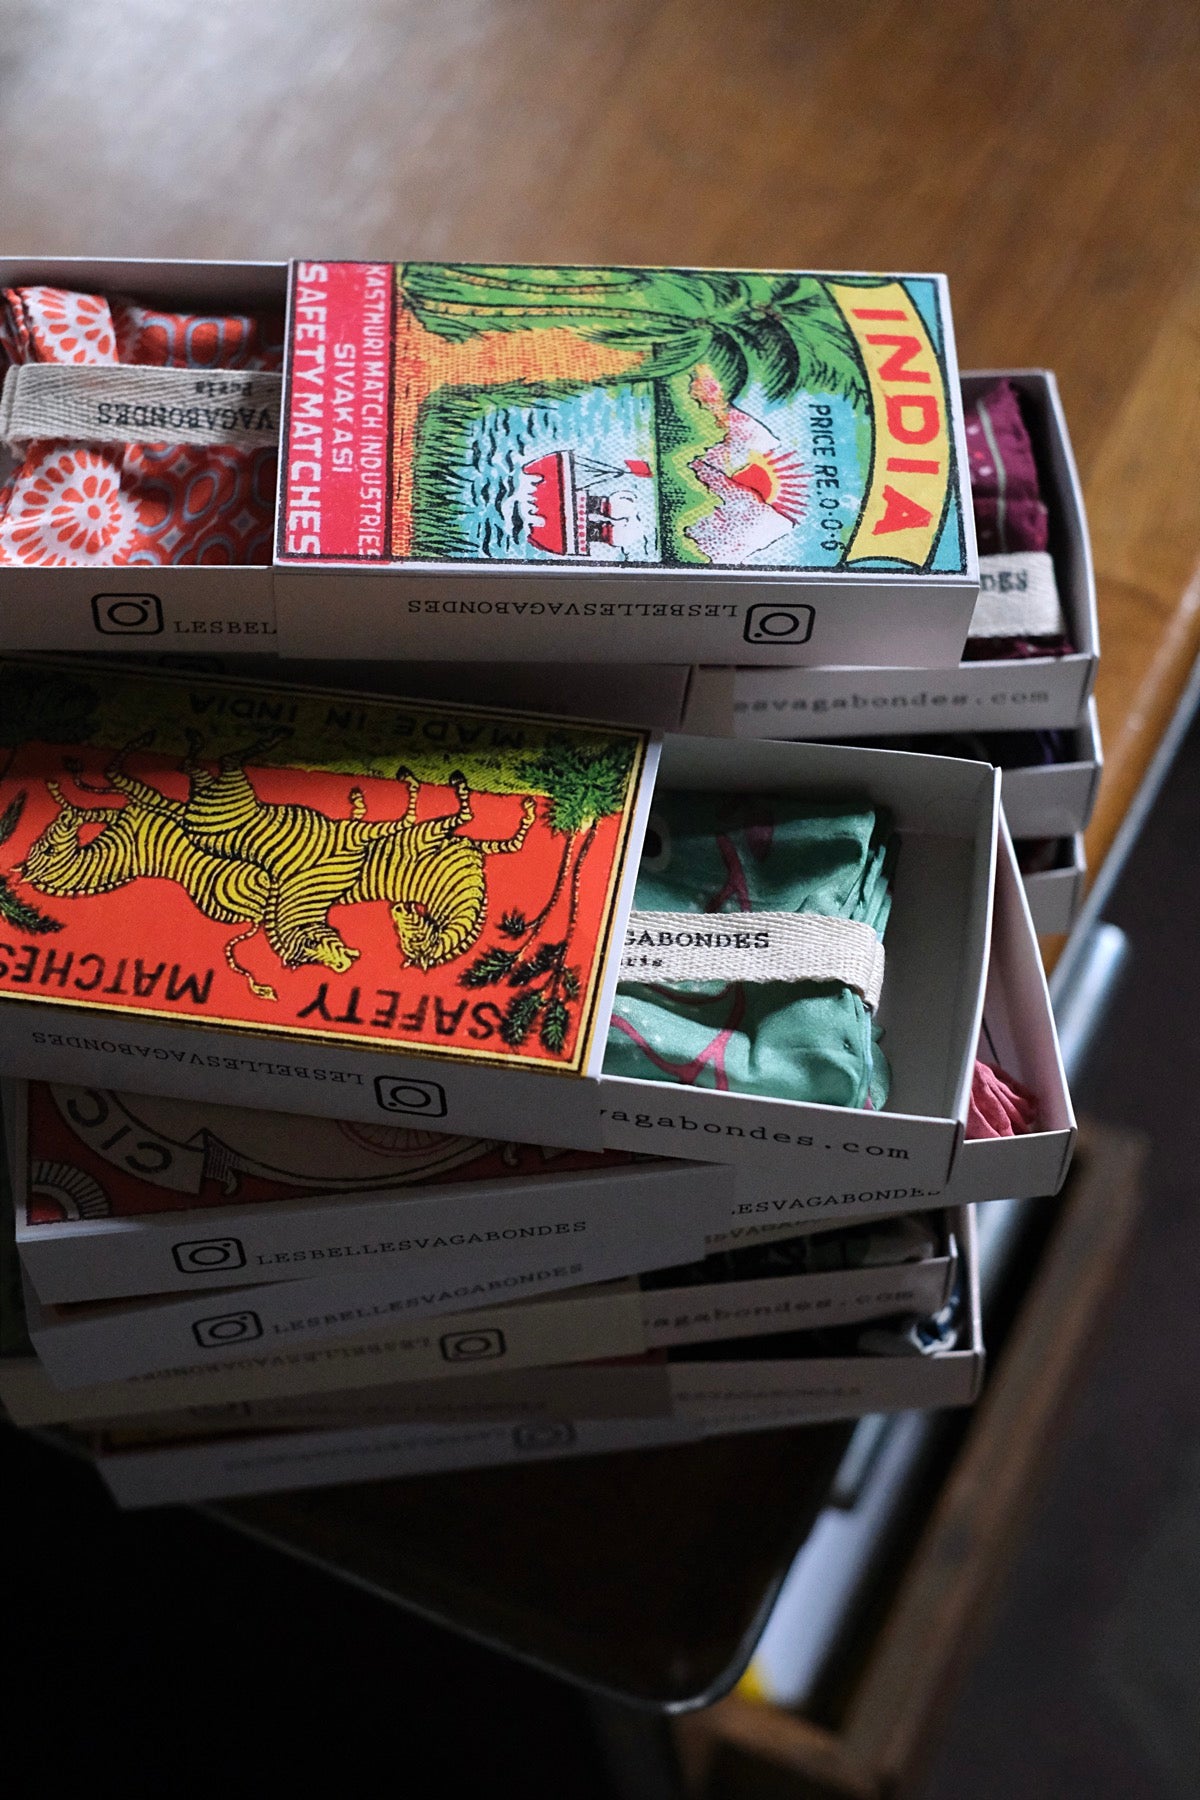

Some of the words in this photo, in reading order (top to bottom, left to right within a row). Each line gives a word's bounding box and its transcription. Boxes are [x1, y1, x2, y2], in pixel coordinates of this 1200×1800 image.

[296, 262, 328, 387] SAFETY
[363, 264, 387, 356] KASTHURI
[97, 402, 277, 430] VAGABONDES
[331, 343, 357, 472] SIVAKASI
[360, 361, 385, 428] MATCH
[809, 404, 836, 457] PRICE
[850, 308, 941, 536] INDIA
[288, 393, 324, 554] MATCHES
[173, 620, 277, 635] LESBEL
[408, 600, 738, 618] LESBELLESVAGABONDES
[187, 692, 299, 723] INDIA
[324, 706, 369, 733] IN
[396, 714, 527, 750] MADE
[297, 982, 504, 1040] SAFETY
[32, 1031, 364, 1085] LESBELLESVAGABONDES
[600, 1107, 911, 1161] agabondes.com
[731, 1186, 941, 1215] ESVAGABONDE
[256, 1220, 586, 1266] LESBELLESVAGABONDES
